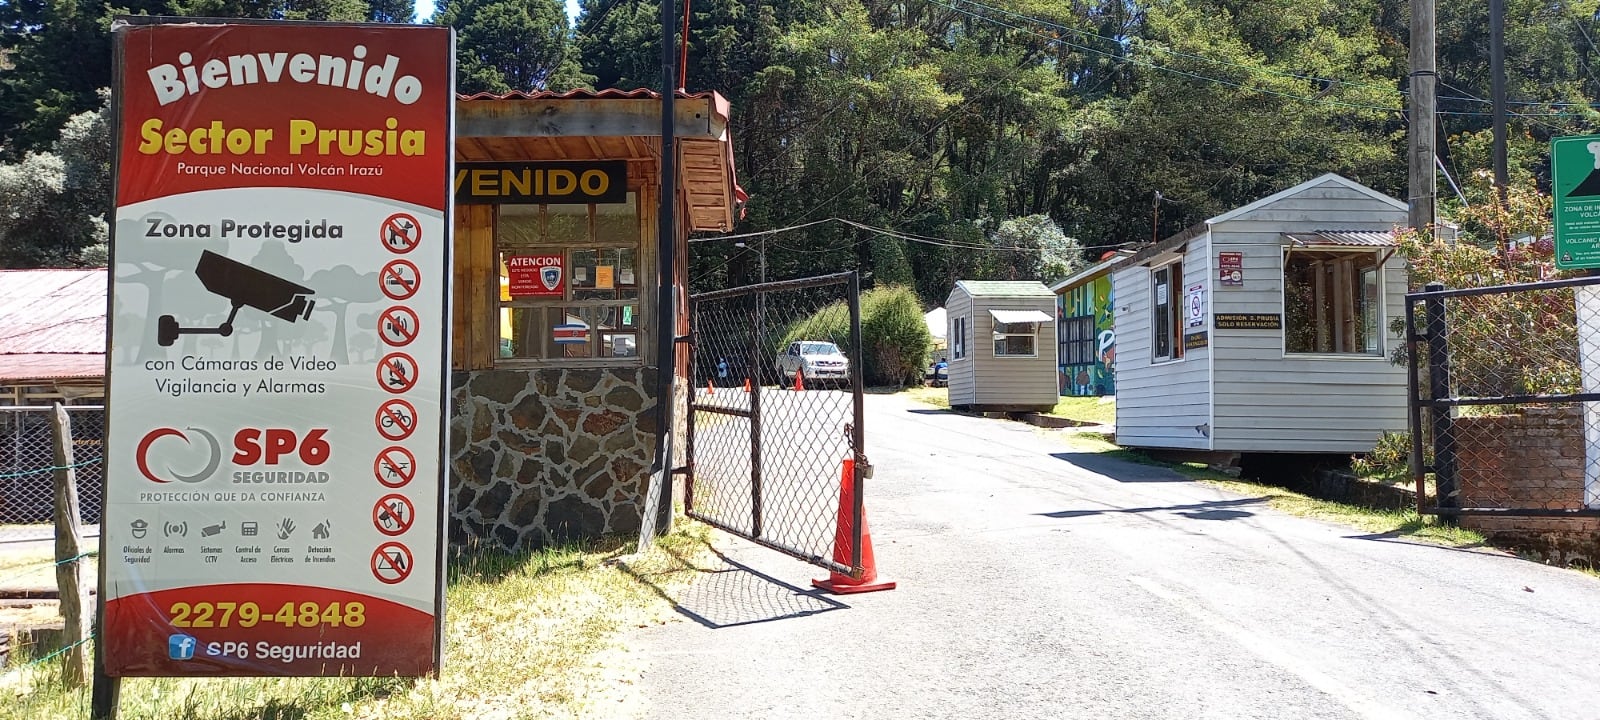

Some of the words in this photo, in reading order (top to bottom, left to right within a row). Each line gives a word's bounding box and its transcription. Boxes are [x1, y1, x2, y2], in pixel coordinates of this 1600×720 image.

[147, 45, 422, 105] Bienvenido
[138, 118, 273, 155] Sector
[289, 117, 426, 156] Prusia
[177, 162, 226, 177] Parque
[231, 162, 293, 176] Nacional
[298, 162, 344, 176] Volcán
[350, 163, 383, 176] Irazú
[145, 219, 211, 238] Zona
[221, 219, 343, 243] Protegida
[510, 257, 561, 267] ATENCION
[145, 360, 175, 371] con
[181, 355, 258, 371] Cámaras
[263, 355, 284, 371] de
[289, 356, 337, 371] Video
[155, 378, 237, 397] Vigilancia
[243, 383, 251, 397] y
[256, 378, 326, 394] Alarmas
[232, 428, 331, 466] SP6
[232, 471, 330, 484] SEGURIDAD
[140, 490, 209, 502] PROTECCIÓN
[214, 492, 237, 502] QUE
[240, 492, 256, 502] DA
[260, 492, 325, 502] CONFIANZA
[204, 555, 218, 564] CCTV
[169, 601, 366, 629] 2279-4848
[206, 641, 249, 659] SP6
[255, 640, 361, 664] Seguridad
